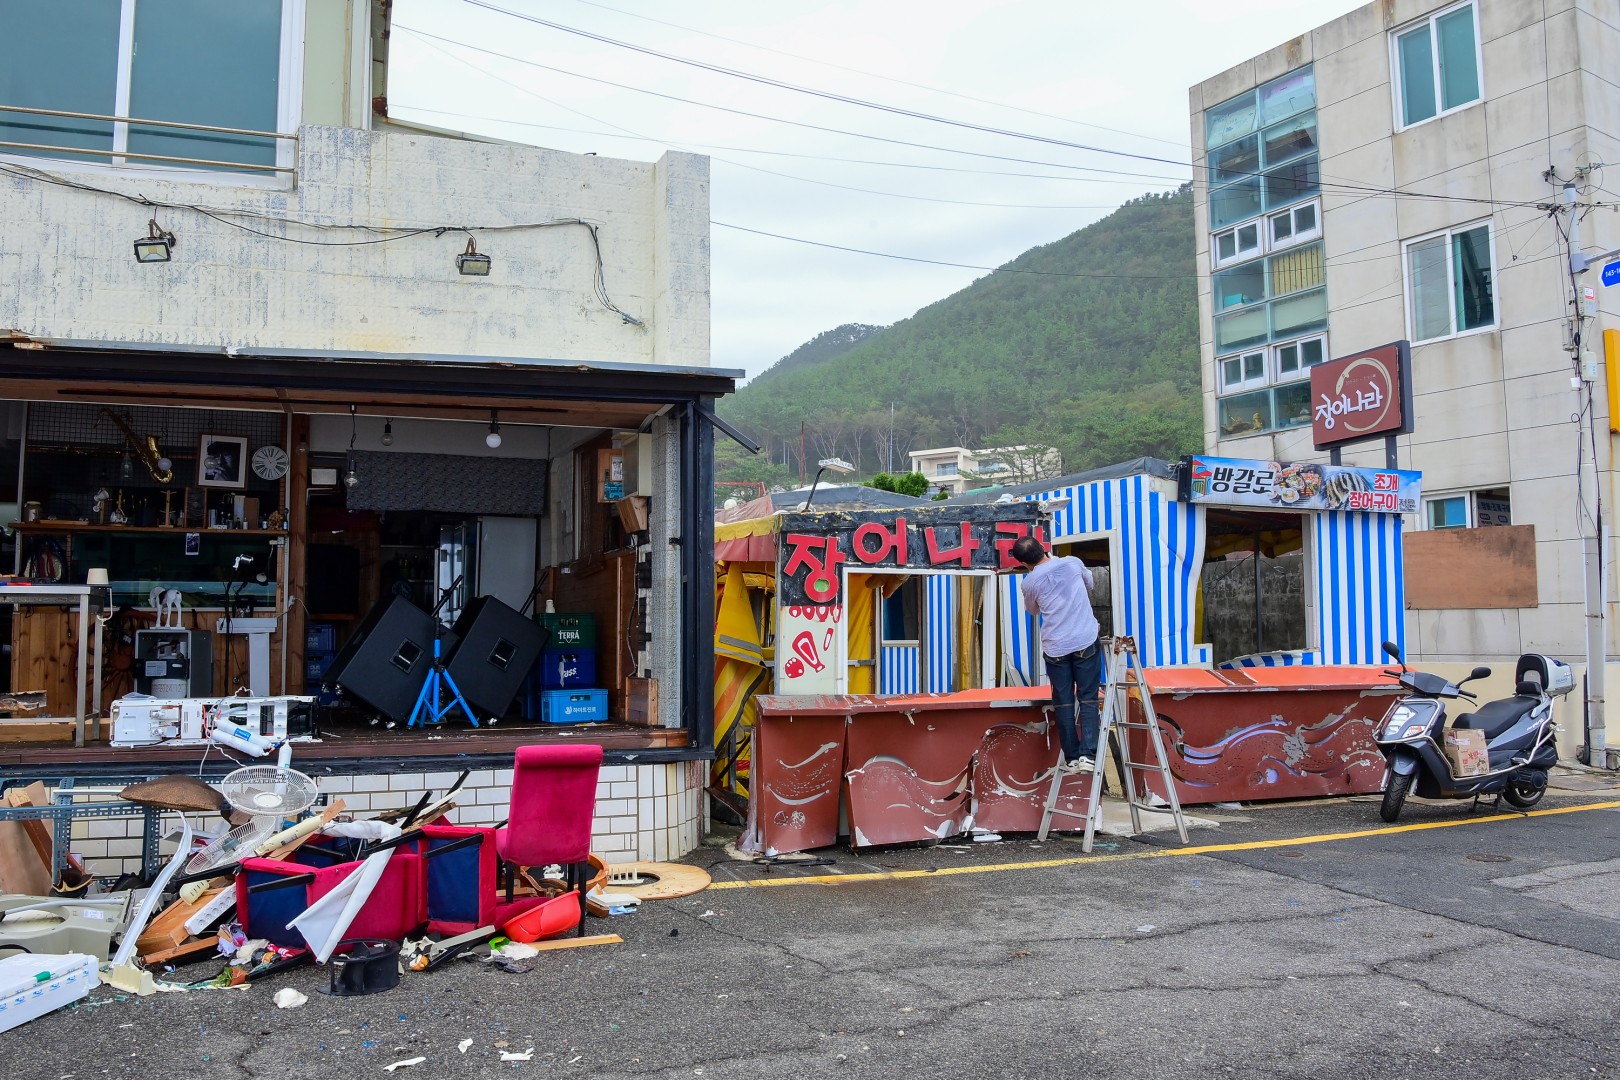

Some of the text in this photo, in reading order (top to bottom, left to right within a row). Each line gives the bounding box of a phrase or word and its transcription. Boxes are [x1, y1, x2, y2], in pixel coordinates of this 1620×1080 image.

[1315, 381, 1383, 430] 장어나라
[1212, 467, 1275, 494] 방갈로
[1374, 473, 1398, 491] 조개
[1349, 491, 1398, 510] 장어구이
[558, 630, 580, 640] TERRA
[563, 667, 577, 679] ass
